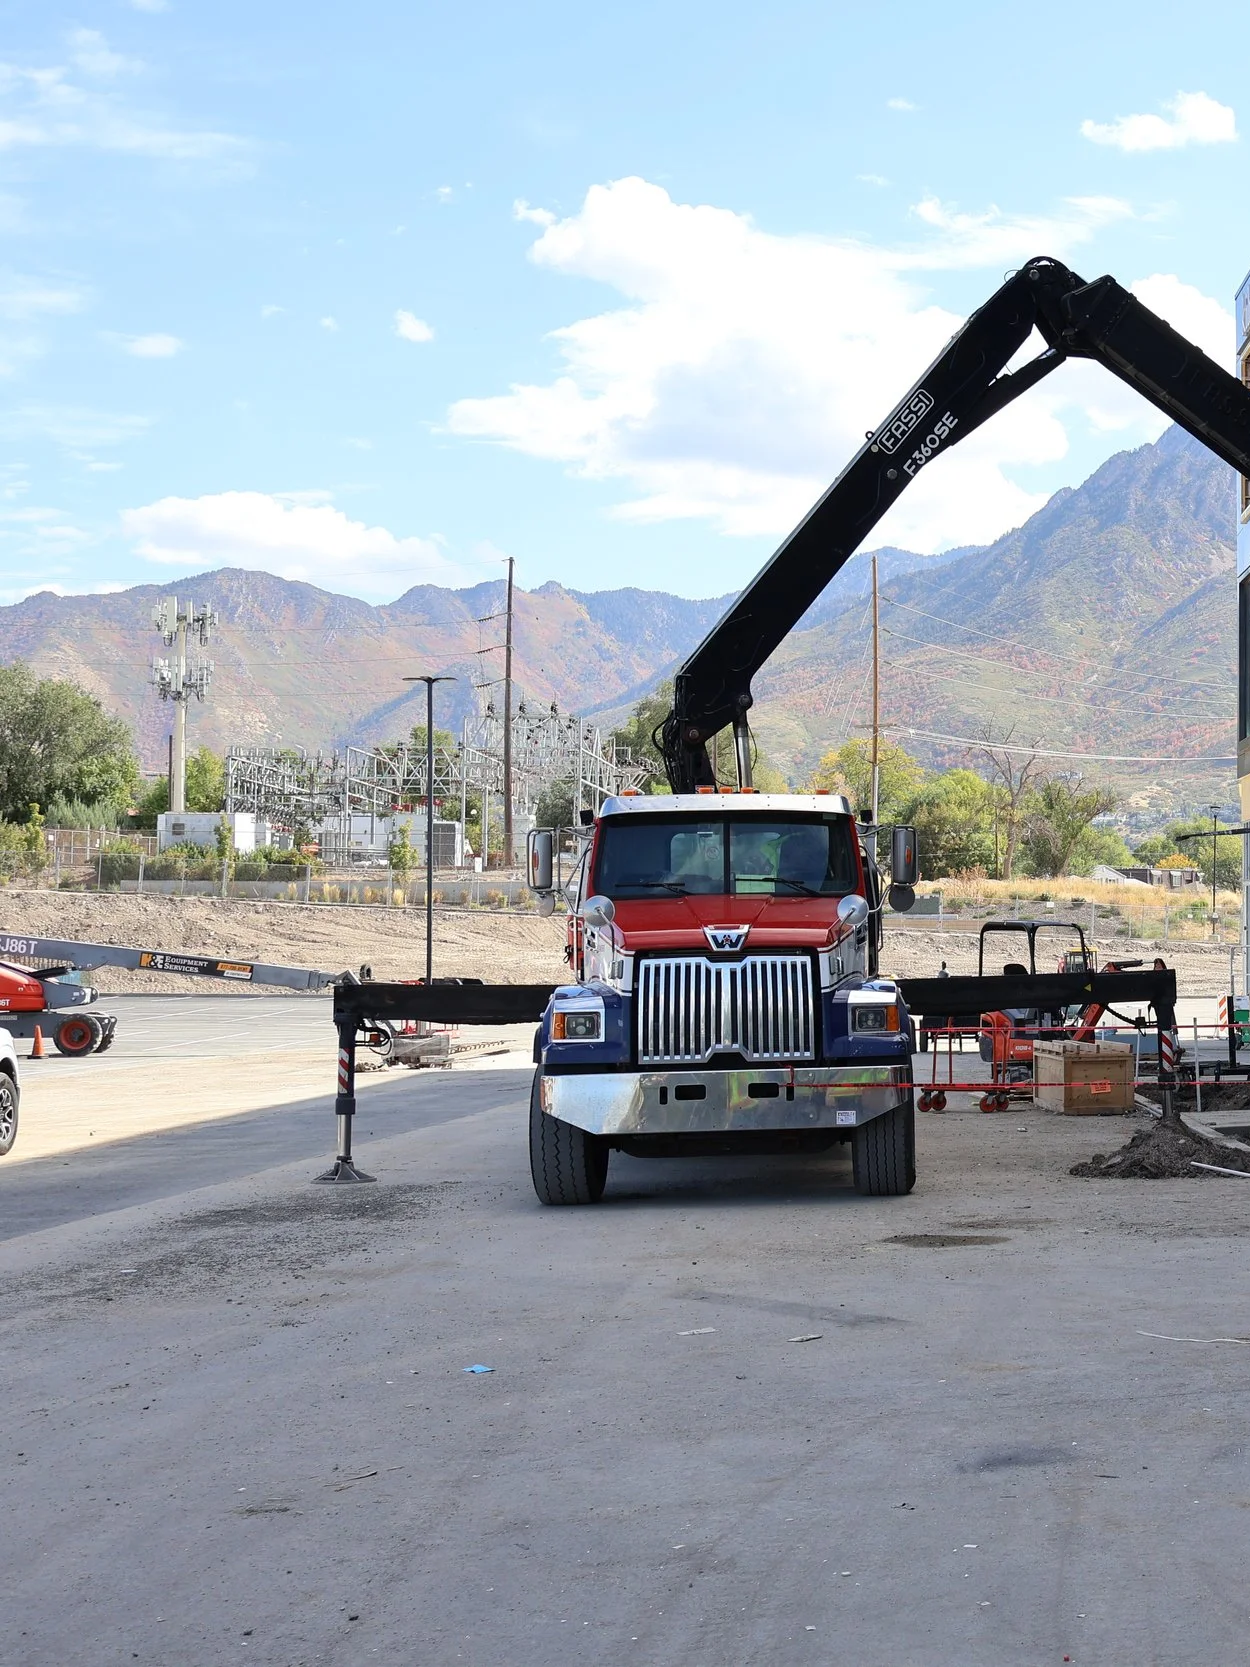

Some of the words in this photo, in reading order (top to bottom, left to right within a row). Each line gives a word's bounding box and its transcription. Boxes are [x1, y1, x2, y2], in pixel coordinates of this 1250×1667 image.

[881, 393, 930, 450] FASSI
[902, 411, 959, 476] F360SE
[164, 963, 199, 973] SERVICES
[165, 955, 209, 967] EQUIPMENT
